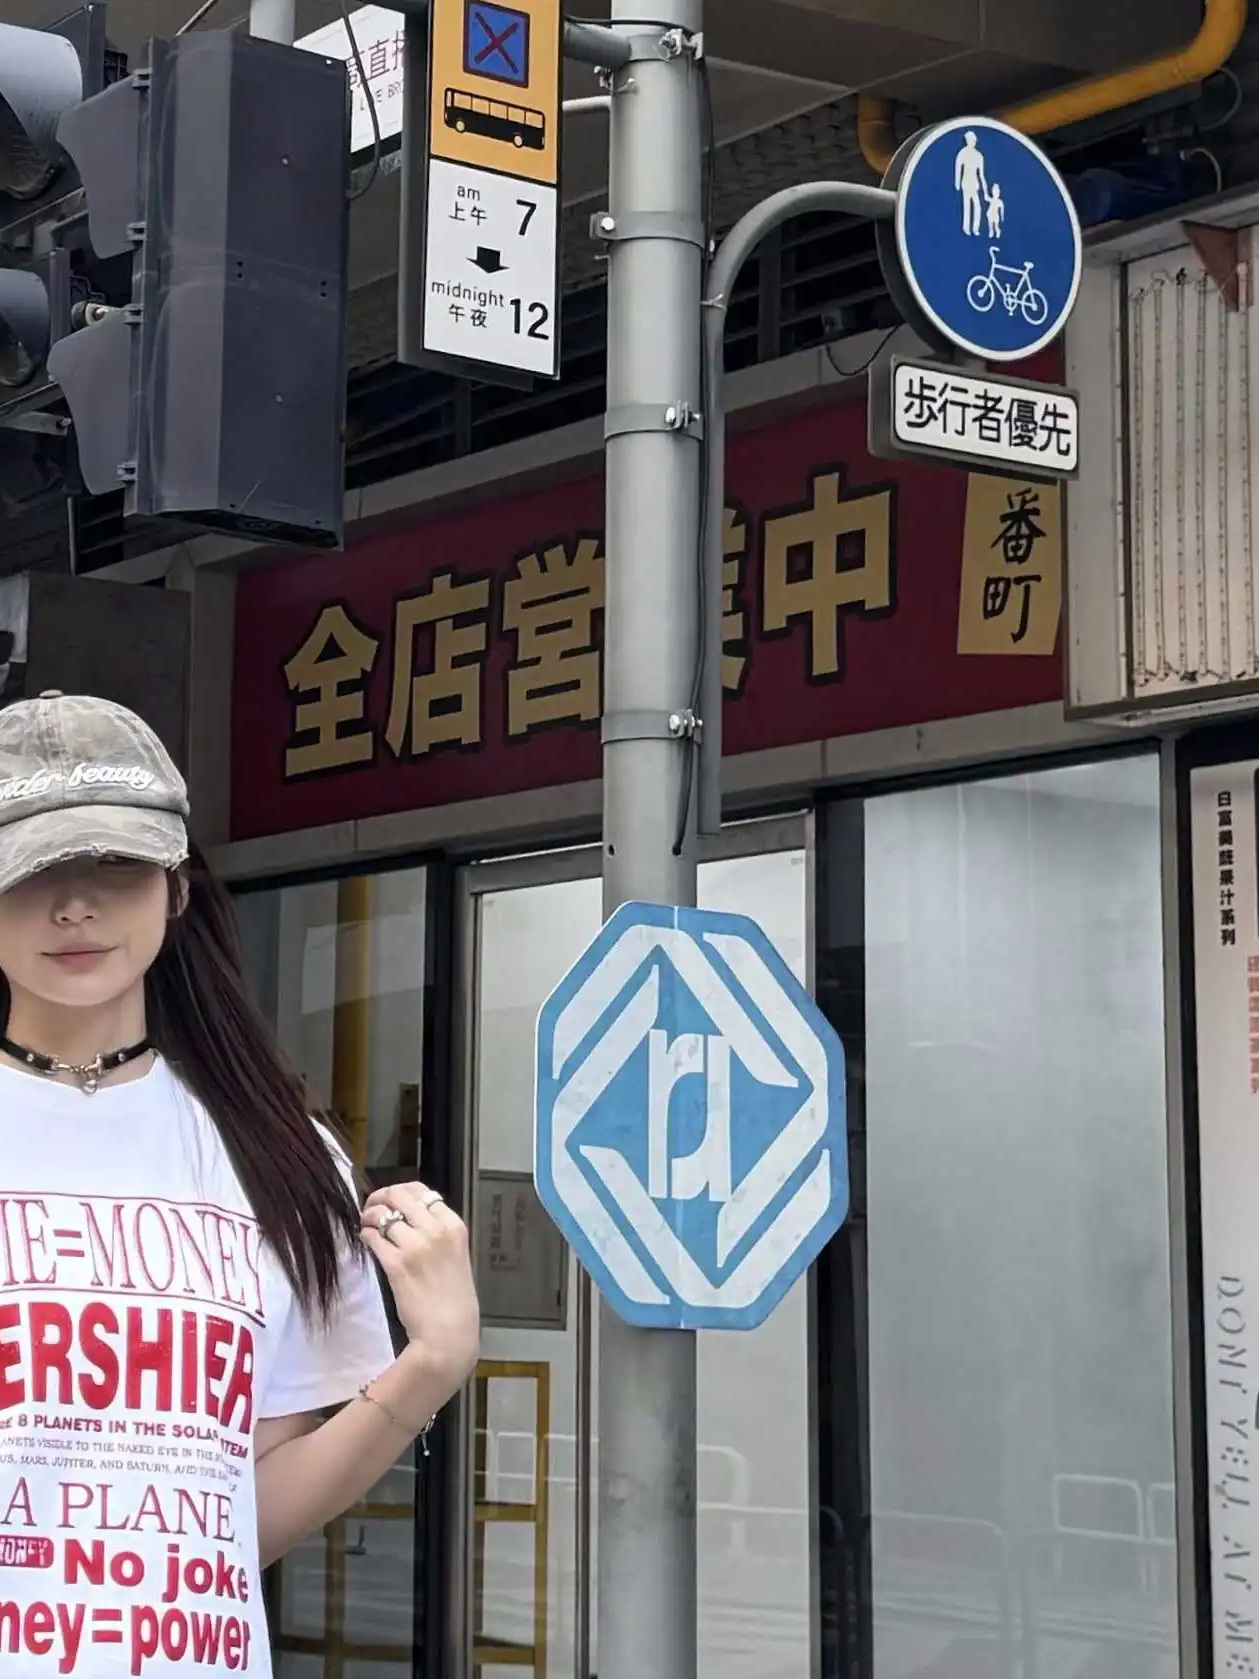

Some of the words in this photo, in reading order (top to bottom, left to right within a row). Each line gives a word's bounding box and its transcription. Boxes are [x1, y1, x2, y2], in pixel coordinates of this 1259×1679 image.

[448, 202, 487, 226] 上午
[456, 185, 481, 200] am
[516, 199, 537, 236] 7
[431, 280, 504, 308] midnight
[510, 298, 549, 340] 12
[448, 303, 488, 329] 午夜
[284, 472, 891, 778] 全店営中
[18, 1413, 29, 1428] 8
[33, 1413, 103, 1433] PLANETS
[108, 1419, 127, 1434] IN
[131, 1421, 167, 1437] THE
[0, 1476, 38, 1527] A
[56, 1481, 242, 1547] PLANE
[63, 1538, 146, 1587] No
[162, 1542, 249, 1604] joke
